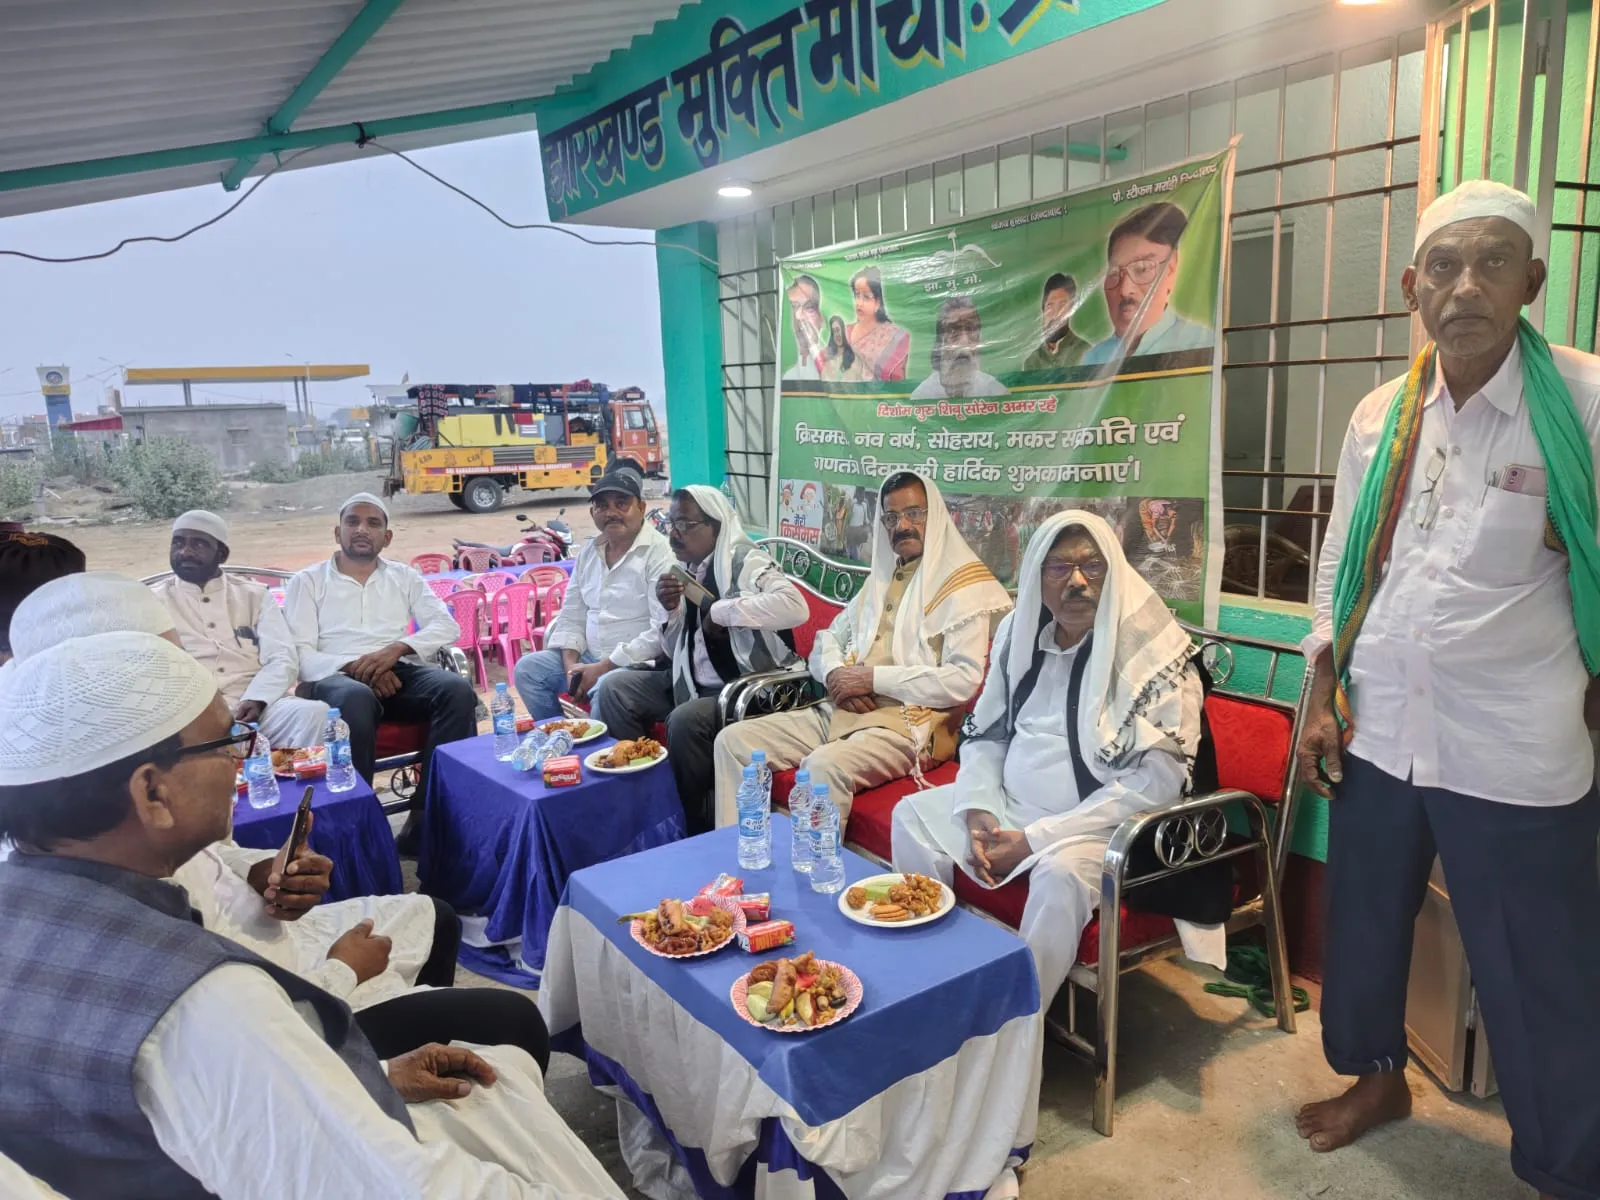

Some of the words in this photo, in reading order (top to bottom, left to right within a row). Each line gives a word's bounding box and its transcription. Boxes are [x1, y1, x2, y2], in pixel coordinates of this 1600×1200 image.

[543, 75, 671, 216] झारखण्ड
[671, 14, 804, 168] मुक्ति
[877, 402, 912, 417] दिशोम
[914, 404, 936, 422] गुरु
[938, 401, 965, 420] शिबू
[965, 399, 999, 415] सोरेन
[1002, 400, 1037, 414] अमर
[1038, 396, 1058, 413] रहे
[854, 431, 885, 448] नव
[889, 426, 921, 450] वर्ष,
[927, 426, 1000, 450] सोहराय,
[1006, 430, 1058, 449] मकर
[1143, 413, 1186, 445] एवं
[944, 457, 1002, 481] हार्दिक
